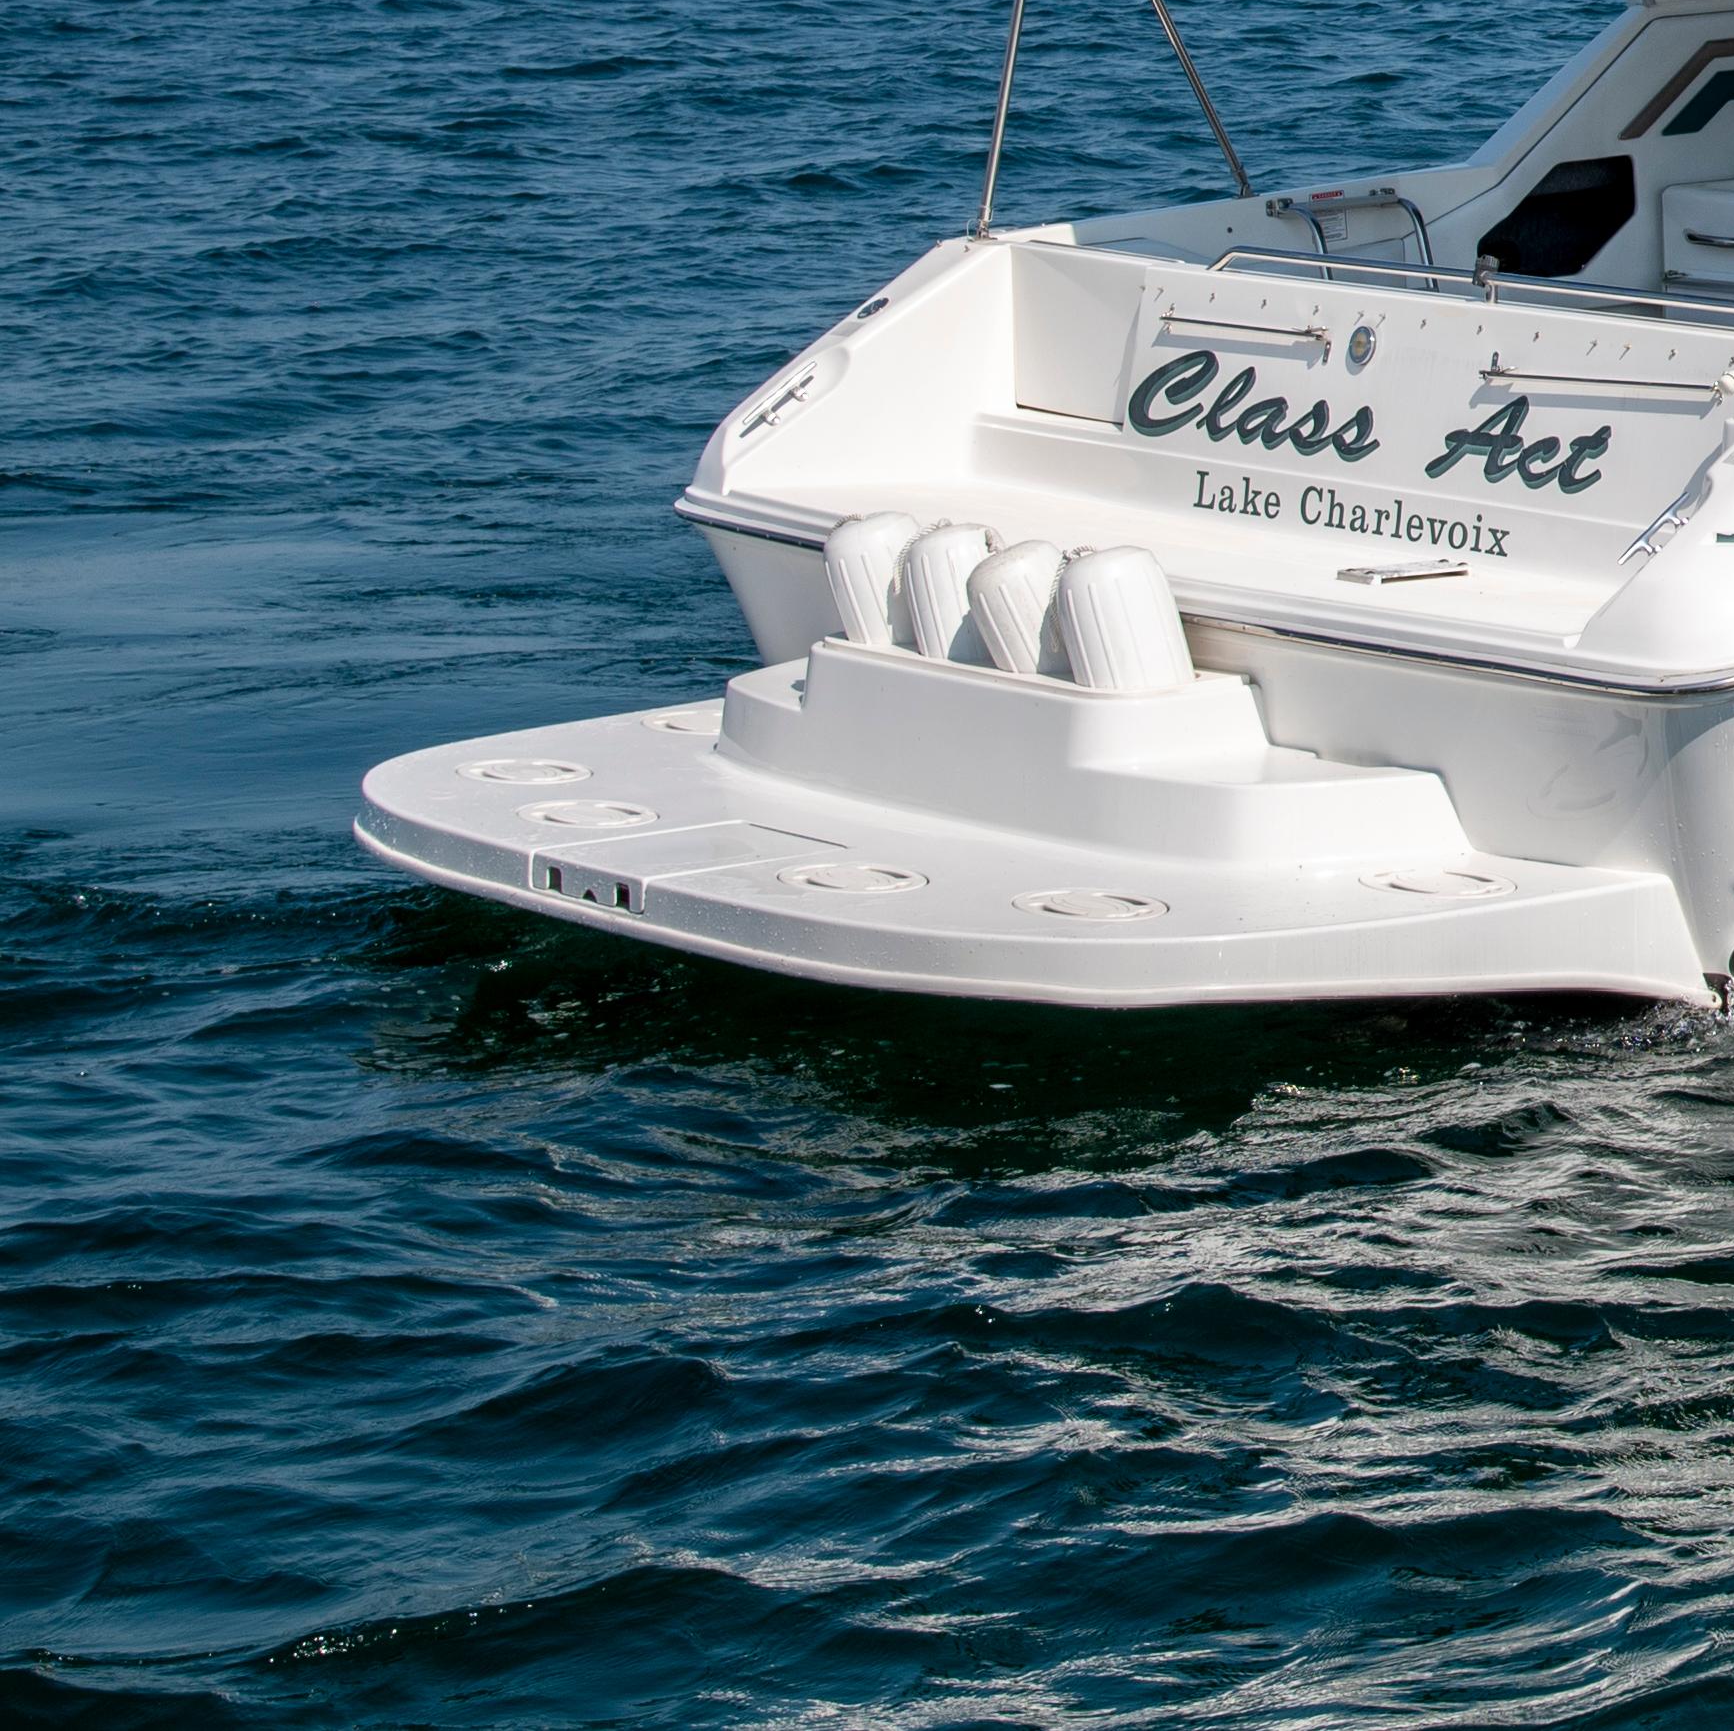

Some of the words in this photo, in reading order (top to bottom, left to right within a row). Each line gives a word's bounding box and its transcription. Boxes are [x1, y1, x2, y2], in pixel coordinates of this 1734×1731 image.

[1128, 349, 1380, 463] Class
[1424, 395, 1612, 495] Act
[1193, 470, 1281, 520] Lake
[1299, 485, 1511, 558] Charlevoix
